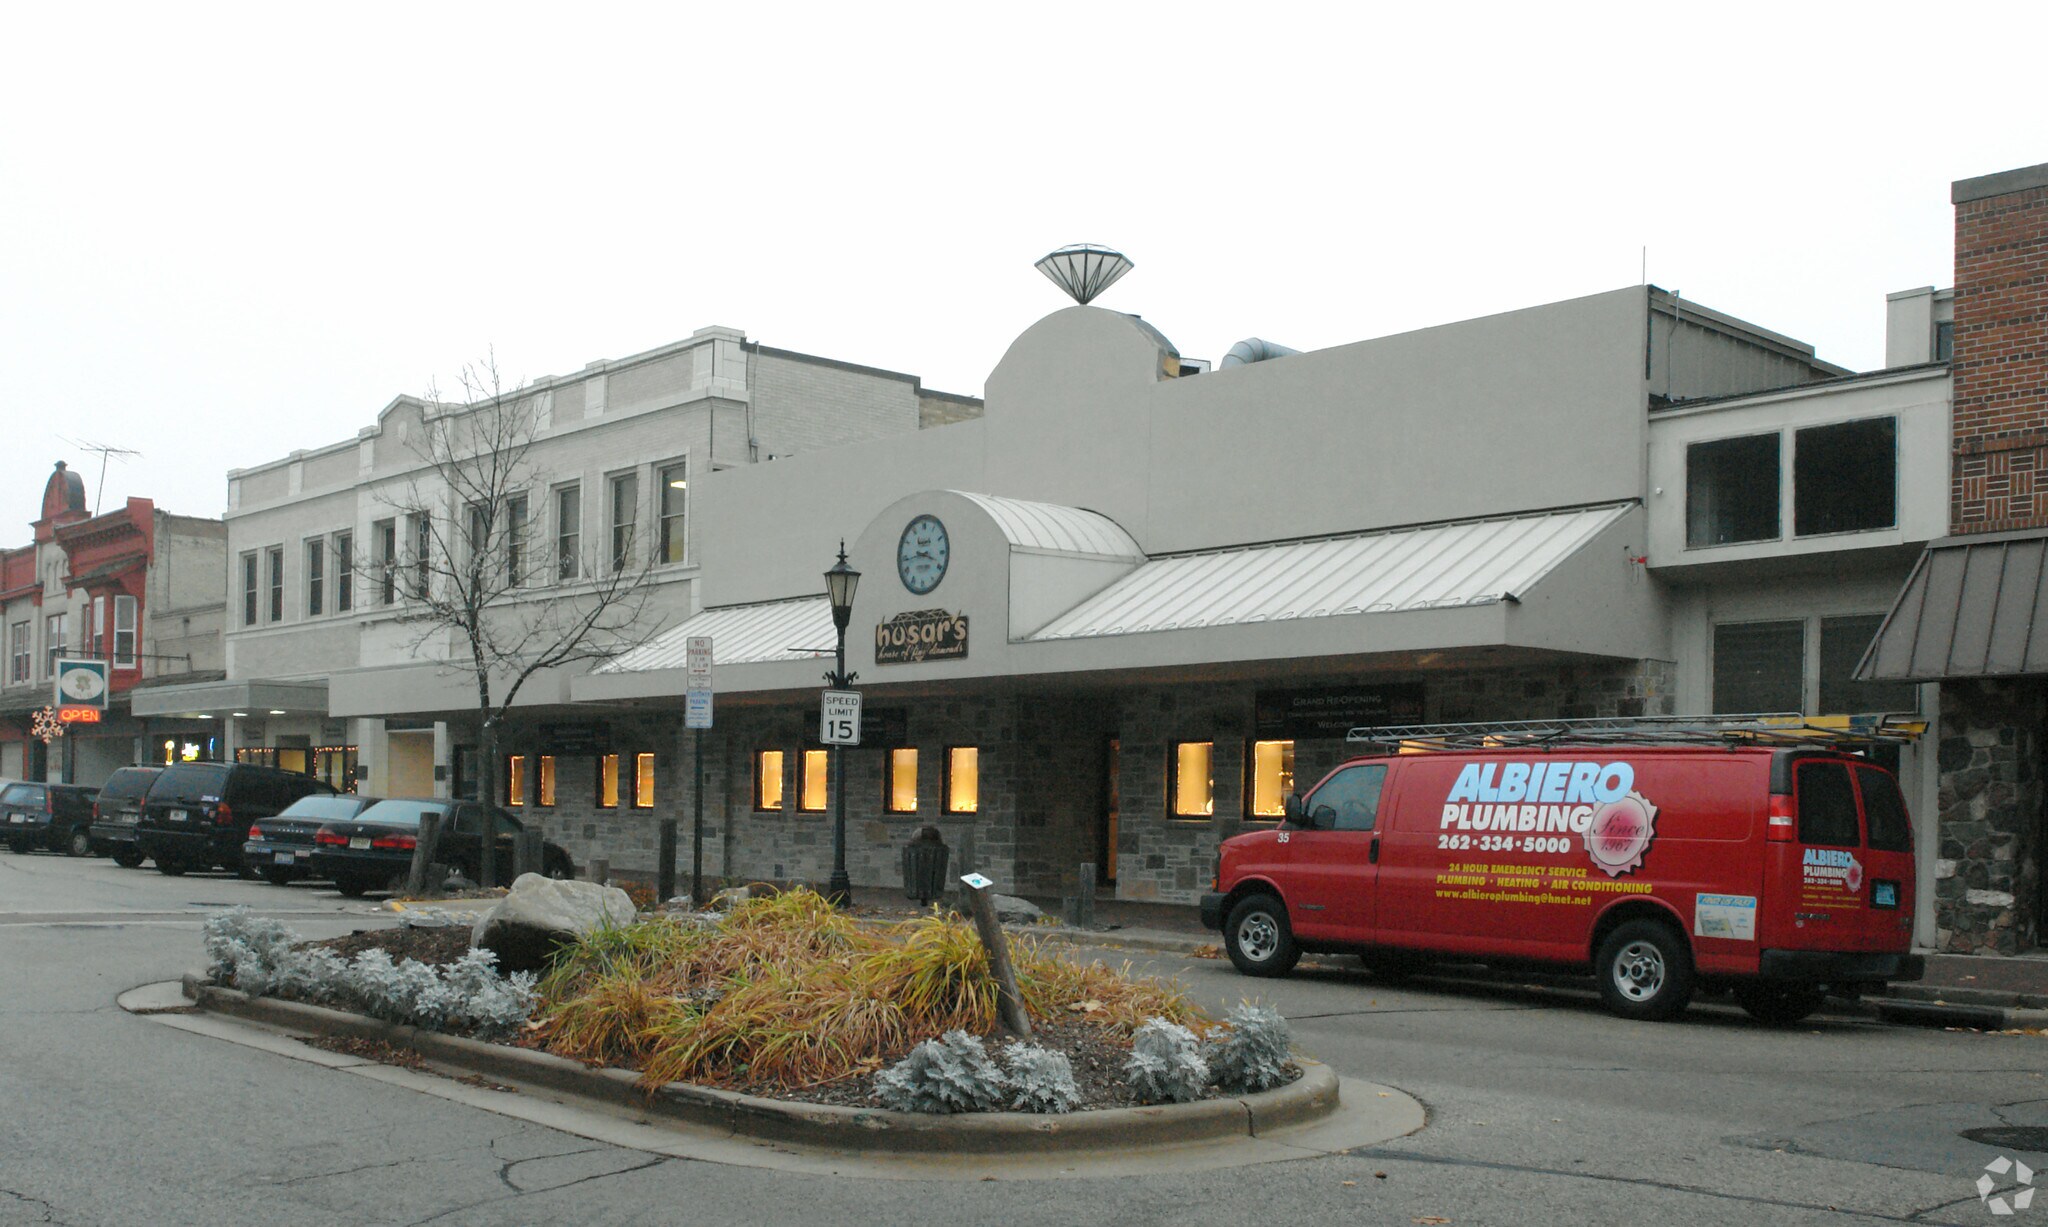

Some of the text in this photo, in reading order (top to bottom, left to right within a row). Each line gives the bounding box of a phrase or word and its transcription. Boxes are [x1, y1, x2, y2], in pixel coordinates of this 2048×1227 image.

[694, 639, 705, 648] NO
[825, 696, 859, 706] SPEED
[60, 708, 100, 722] OPEN
[828, 707, 854, 717] LIMIT
[828, 720, 853, 740] 15
[1446, 761, 1635, 804] ALBIERO
[1440, 803, 1593, 833] PLUMBING
[1593, 810, 1645, 836] Since
[1277, 832, 1290, 844] 35
[1600, 838, 1634, 852] 1967
[1803, 848, 1853, 868] ALBIERO
[1449, 863, 1588, 878] 24 HOUR EMERGENCY SERVICE
[1804, 866, 1847, 878] PLUMBING
[1436, 875, 1653, 894] PLUMBING HEATING AIR CONDITIONING
